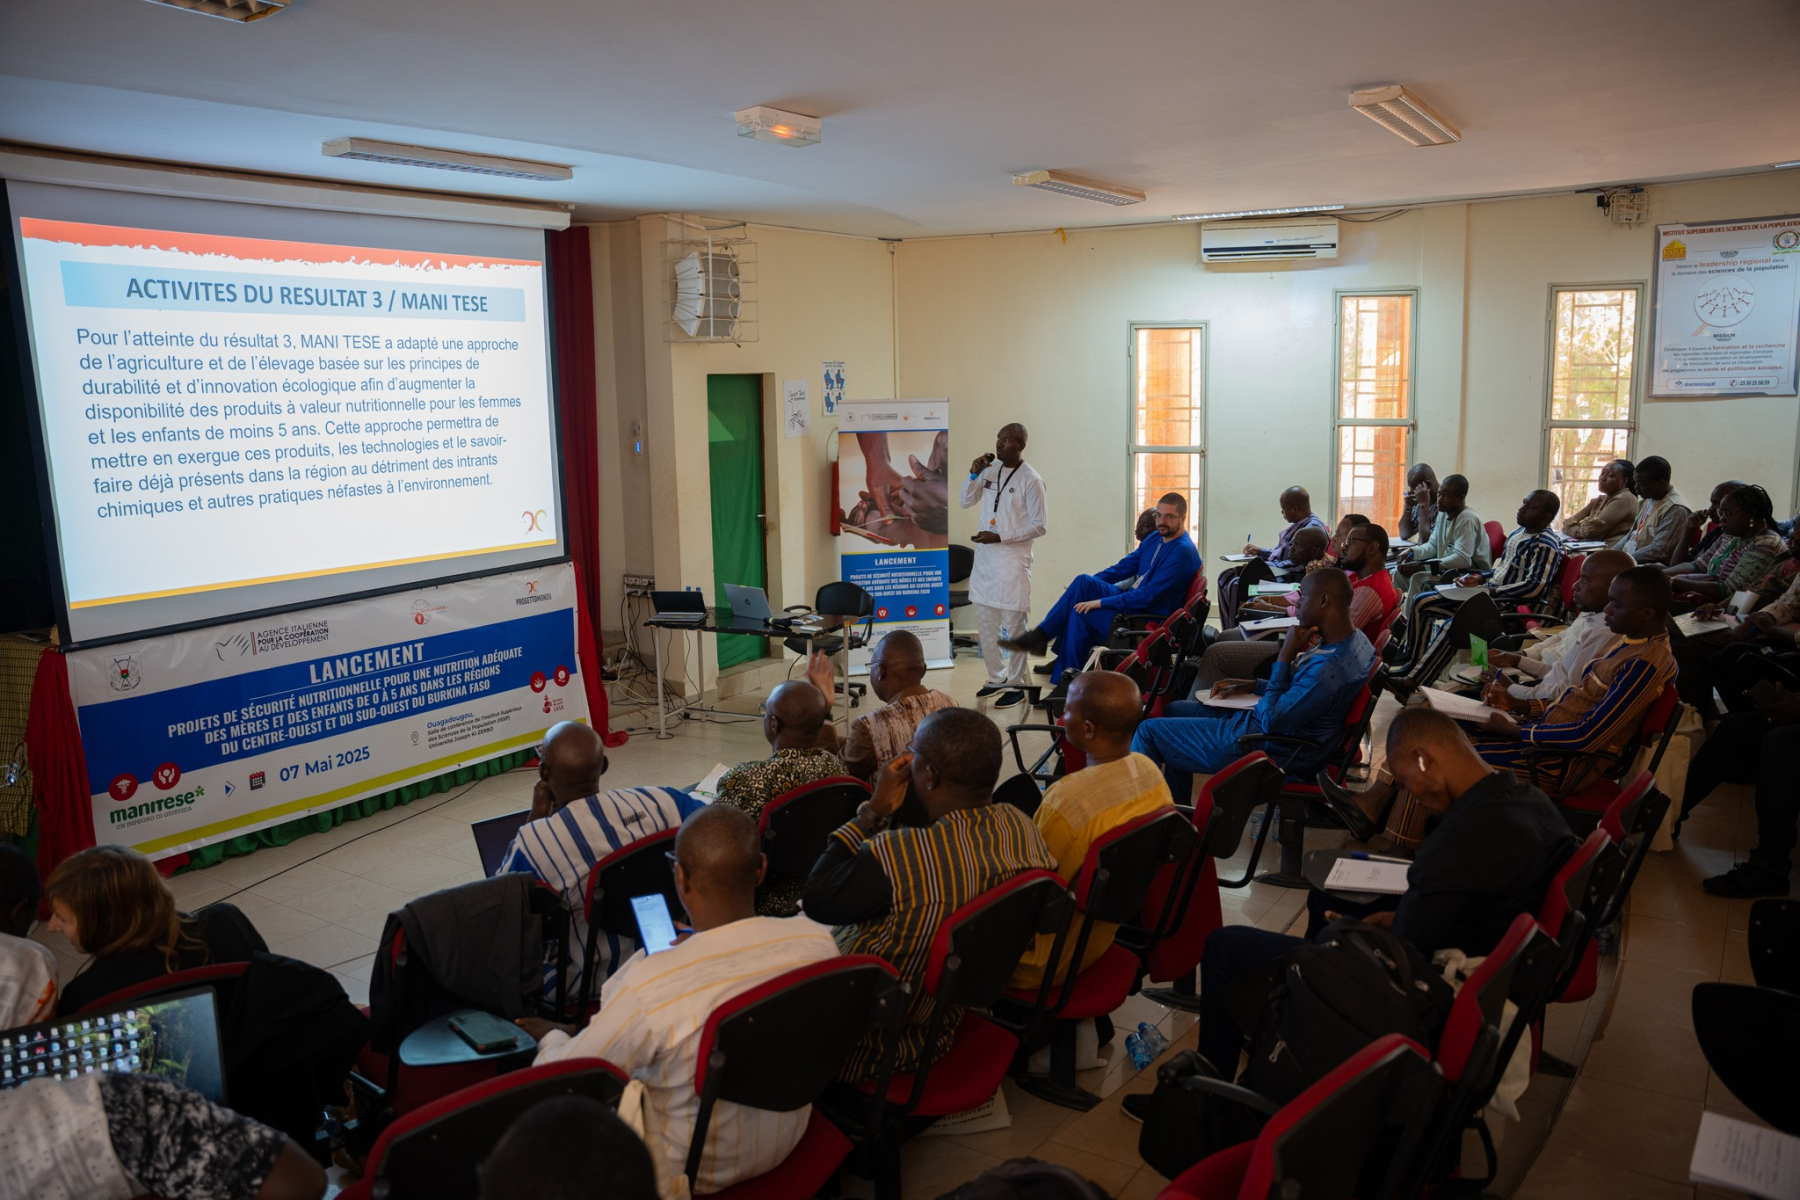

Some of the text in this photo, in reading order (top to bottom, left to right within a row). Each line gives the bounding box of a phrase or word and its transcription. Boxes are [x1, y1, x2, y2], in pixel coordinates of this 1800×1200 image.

[1768, 220, 1800, 228] POPULATIO
[125, 277, 489, 313] ACTIVITES DU RESULTAT 3 / MANI TESE
[76, 327, 519, 353] Pour l'atteinte du résultat 3, MANI TESE a adapté une approche
[79, 353, 480, 375] de l'agriculture et de l'élevage basée sur les principes de
[84, 395, 522, 424] disponibilité des produits à valeur nutritionnelle pour les femmes
[91, 435, 507, 470] mettre en exergue ces produits, les technologies et le savoir-
[93, 453, 498, 494] faire déjà présents dans la région au détriment des intrants
[97, 474, 493, 519] chimiques et autres pratiques néfastes à l'environnement.
[874, 557, 917, 566] LANCEMENT
[257, 620, 328, 639] AGENCE ITALIENNE
[258, 637, 274, 645] POUR
[284, 628, 329, 640] COOPÉRATION
[271, 634, 329, 651] DÉVELOPPEMENT
[309, 642, 425, 685] LANCEMENT
[167, 646, 523, 738] PROJETS DE SÉCURITÉ NUTRITIONNELLE POUR UNE NUTRITION ADÉQUATE
[205, 664, 501, 745] DES MÈRES ET DES ENFANTS DE 0 À 5 ANS DANS LES RÉGIONS
[221, 679, 490, 755] DU CENTRE-OUEST ET DU SUD-OUEST DU BURKINA FASO
[427, 712, 474, 728] Ouagadougou,
[279, 746, 370, 782] 07 Mai 2025
[126, 815, 155, 828] IMPEGNO
[164, 806, 193, 818] GIUSTIZIA
